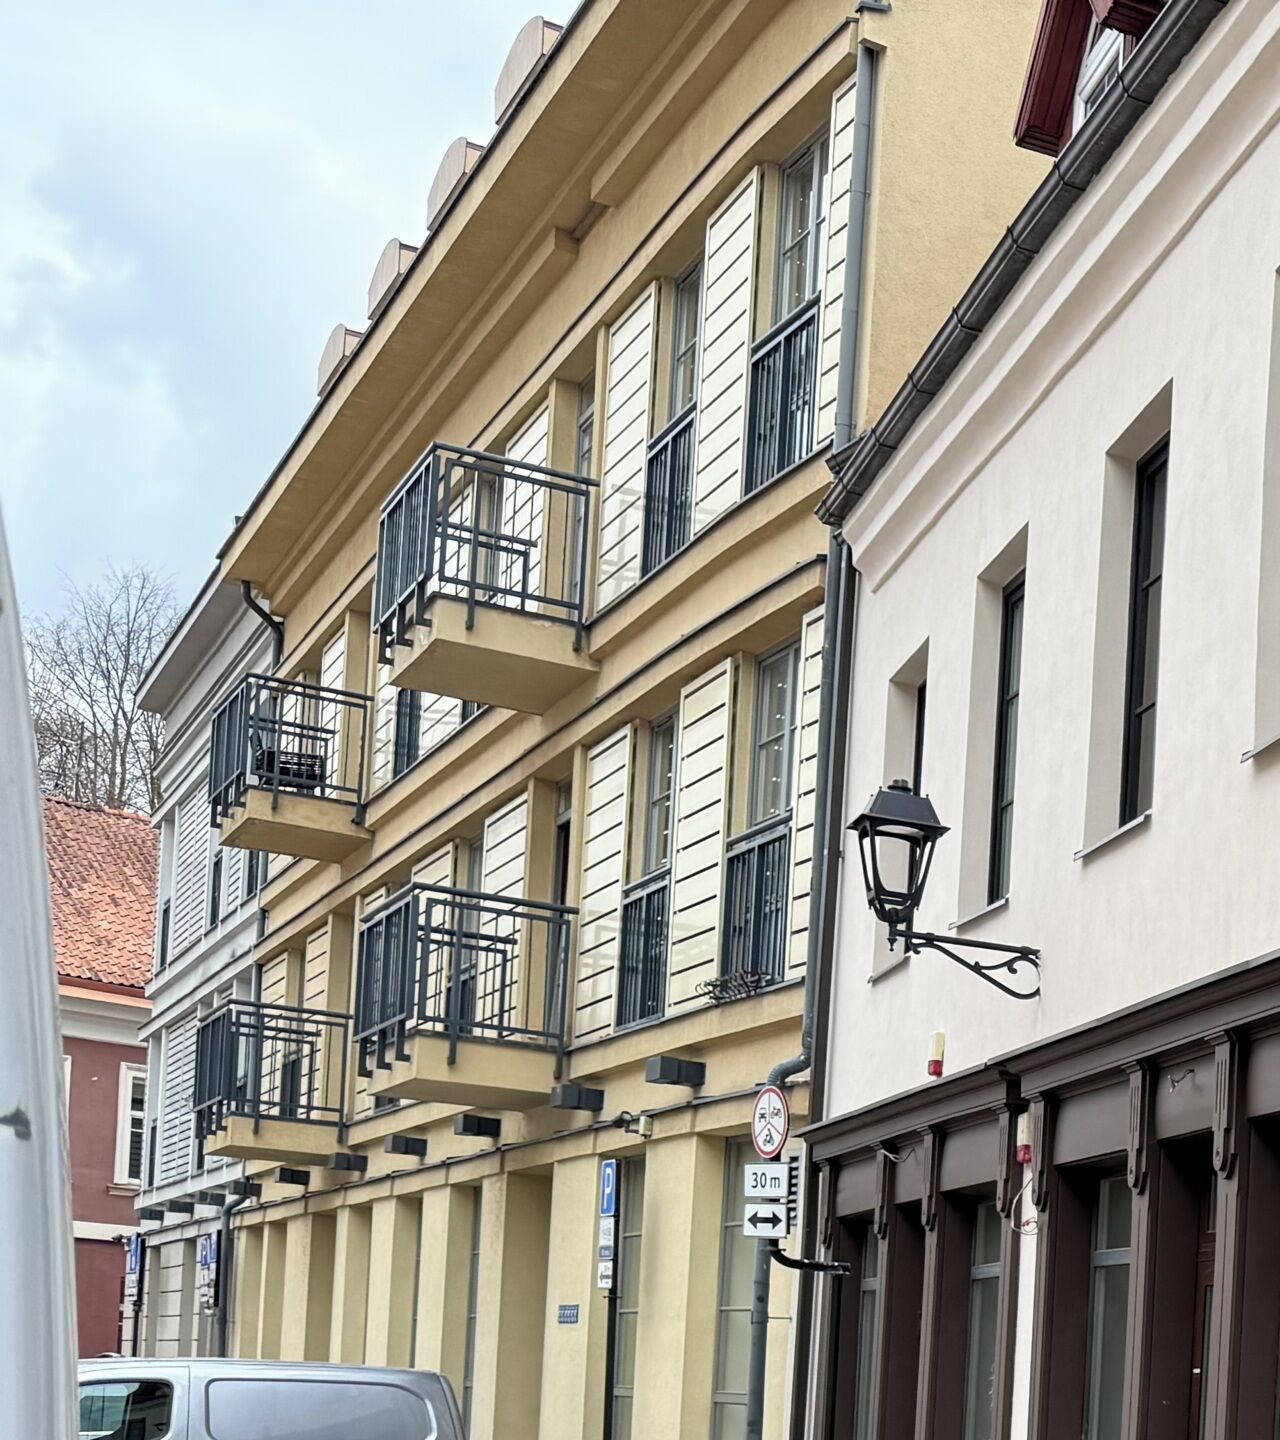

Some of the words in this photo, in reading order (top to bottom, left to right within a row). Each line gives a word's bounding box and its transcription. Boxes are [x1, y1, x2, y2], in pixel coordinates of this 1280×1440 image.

[603, 1167, 613, 1209] P
[751, 1172, 767, 1189] 30
[770, 1177, 780, 1189] m
